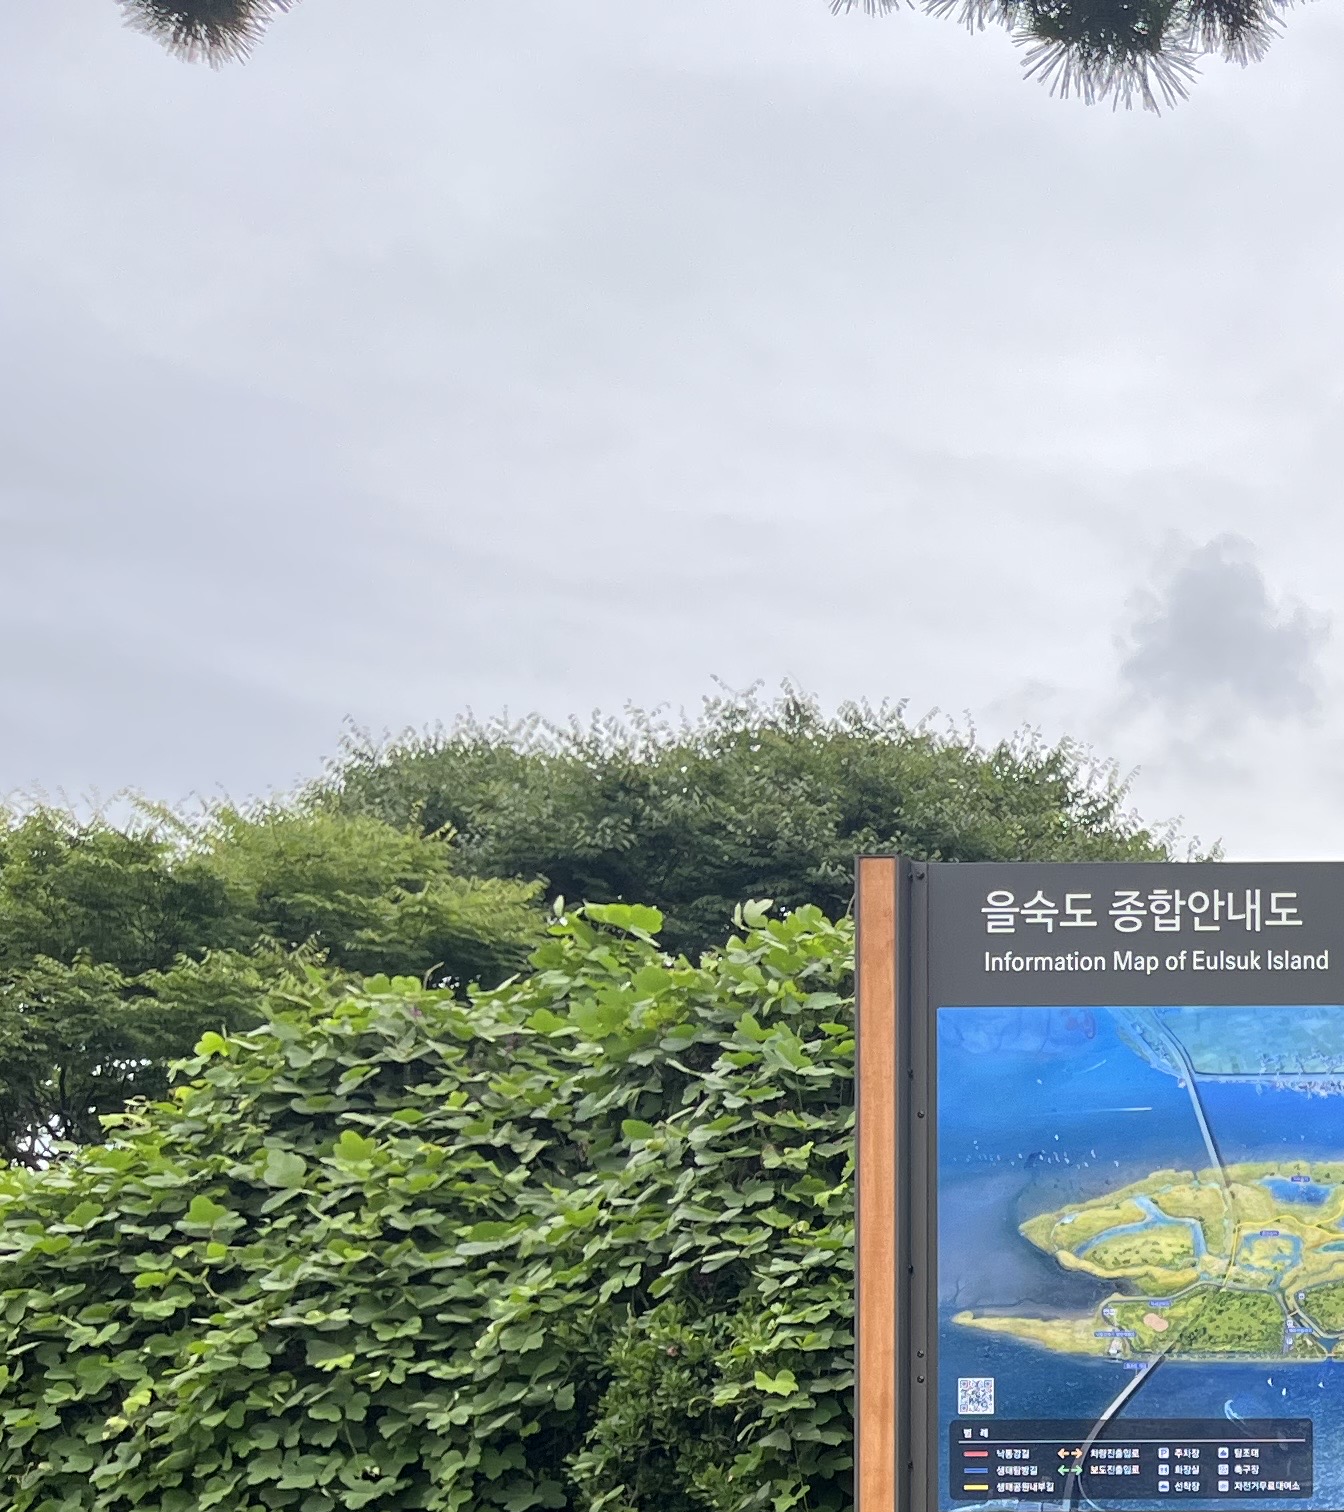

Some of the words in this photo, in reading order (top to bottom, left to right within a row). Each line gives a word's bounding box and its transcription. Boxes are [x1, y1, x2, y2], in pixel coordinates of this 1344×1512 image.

[980, 890, 1097, 933] 을숙도
[1108, 889, 1302, 932] 종합안내도
[985, 951, 1105, 971] Information
[1113, 950, 1158, 974] Map
[1165, 950, 1187, 970] of
[1192, 950, 1261, 970] Eulsuk
[1267, 949, 1328, 970] Island
